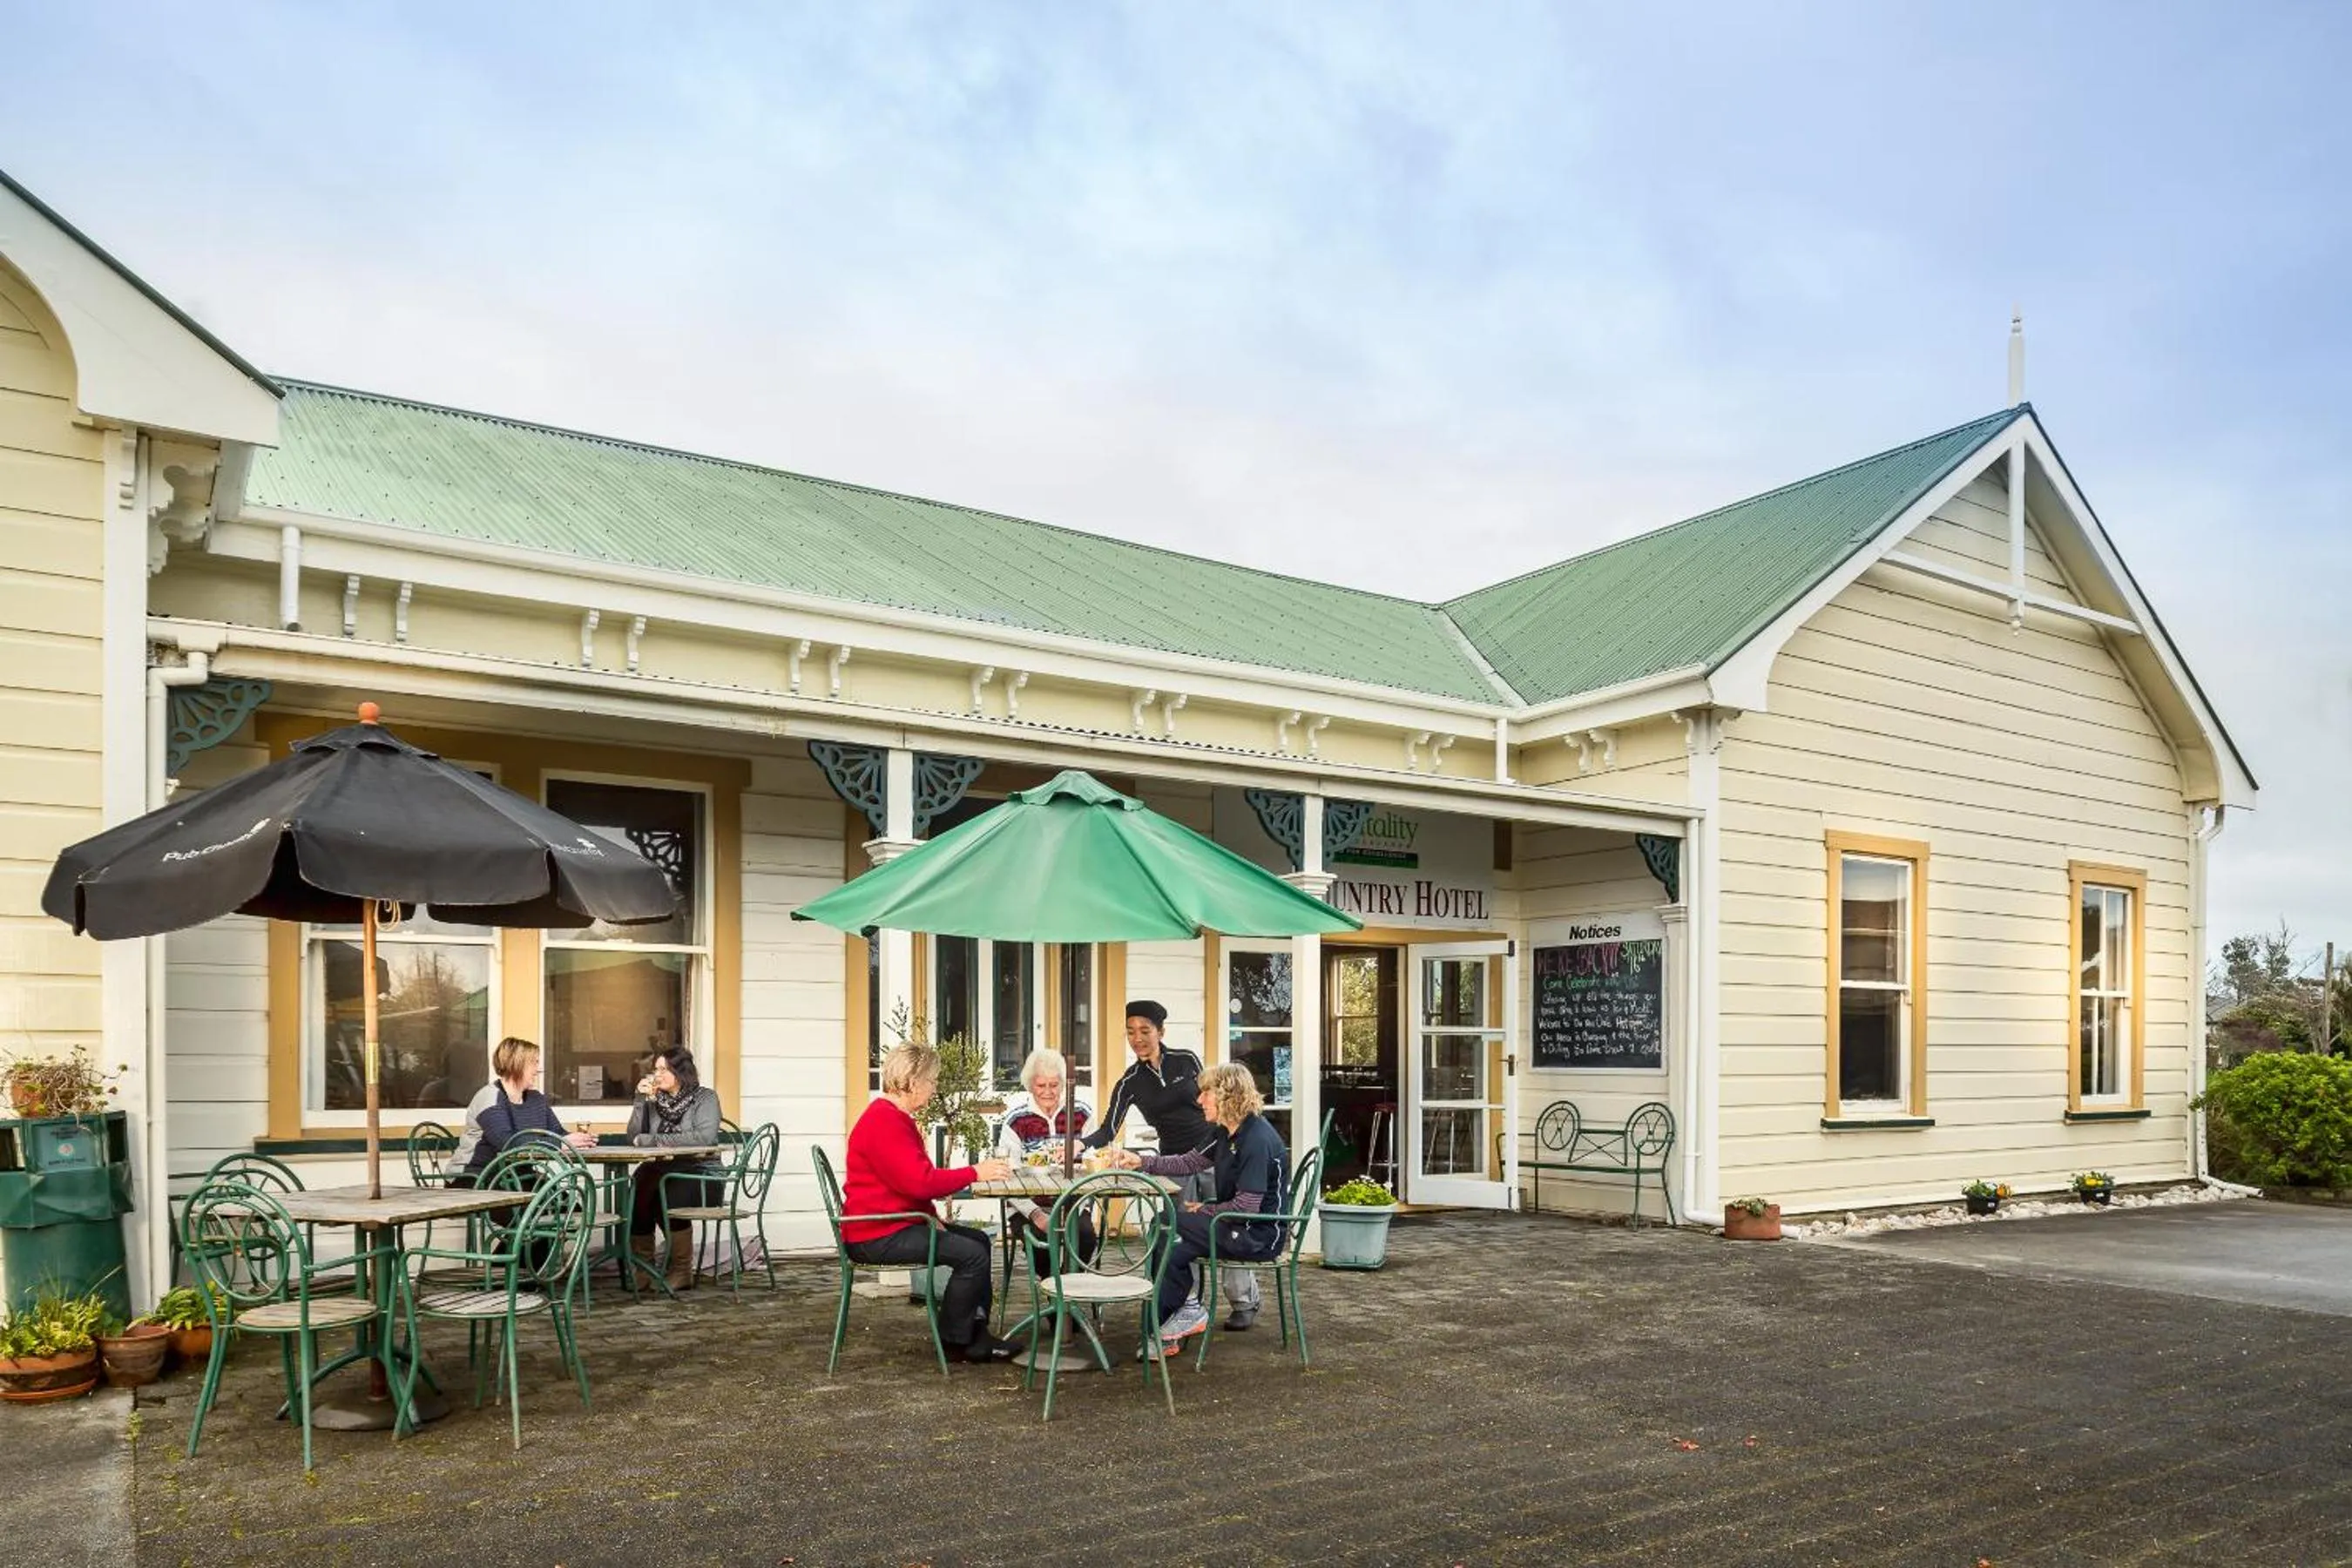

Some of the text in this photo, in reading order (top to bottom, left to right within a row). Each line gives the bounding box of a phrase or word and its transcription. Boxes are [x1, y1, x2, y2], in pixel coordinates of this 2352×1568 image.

[1327, 881, 1489, 920] UNTRY HOTEL
[1569, 924, 1621, 940] Notices
